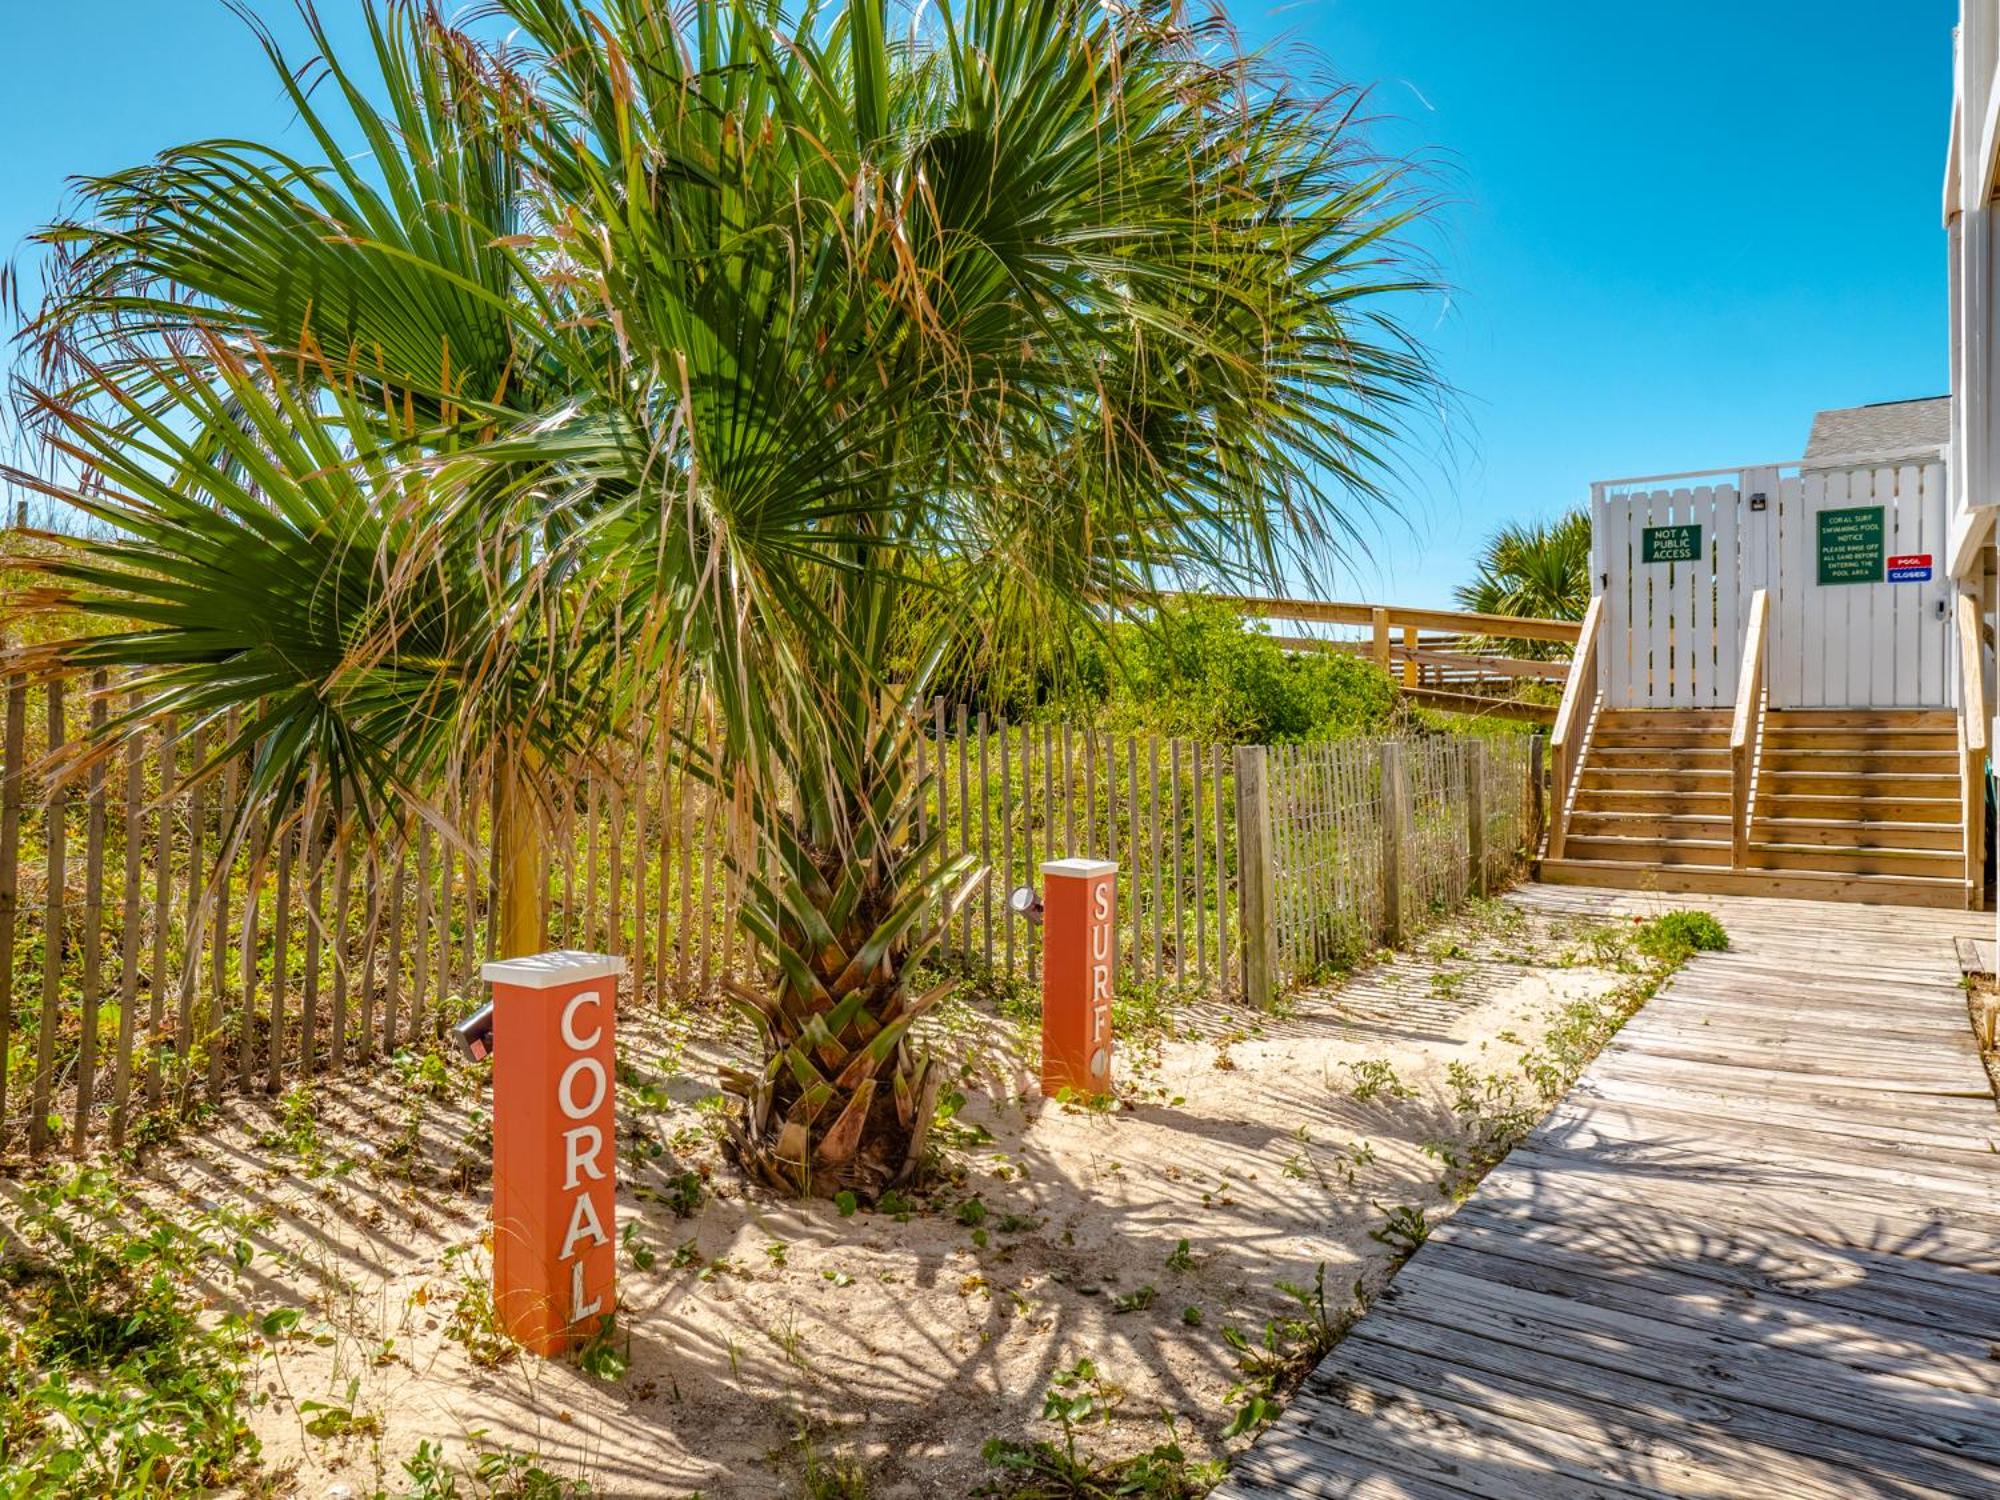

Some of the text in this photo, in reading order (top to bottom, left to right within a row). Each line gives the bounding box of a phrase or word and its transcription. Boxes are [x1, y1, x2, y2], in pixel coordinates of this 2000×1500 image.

[1654, 529, 1689, 539] NOT A
[1654, 538, 1690, 549] PUBLIC
[1653, 548, 1692, 559] ACCESS
[1822, 545, 1845, 553] PLEASE
[1828, 561, 1859, 569] ENTERING
[1892, 571, 1927, 579] CLOSED
[1092, 882, 1110, 1043] SURF
[558, 991, 609, 1323] CORAL
